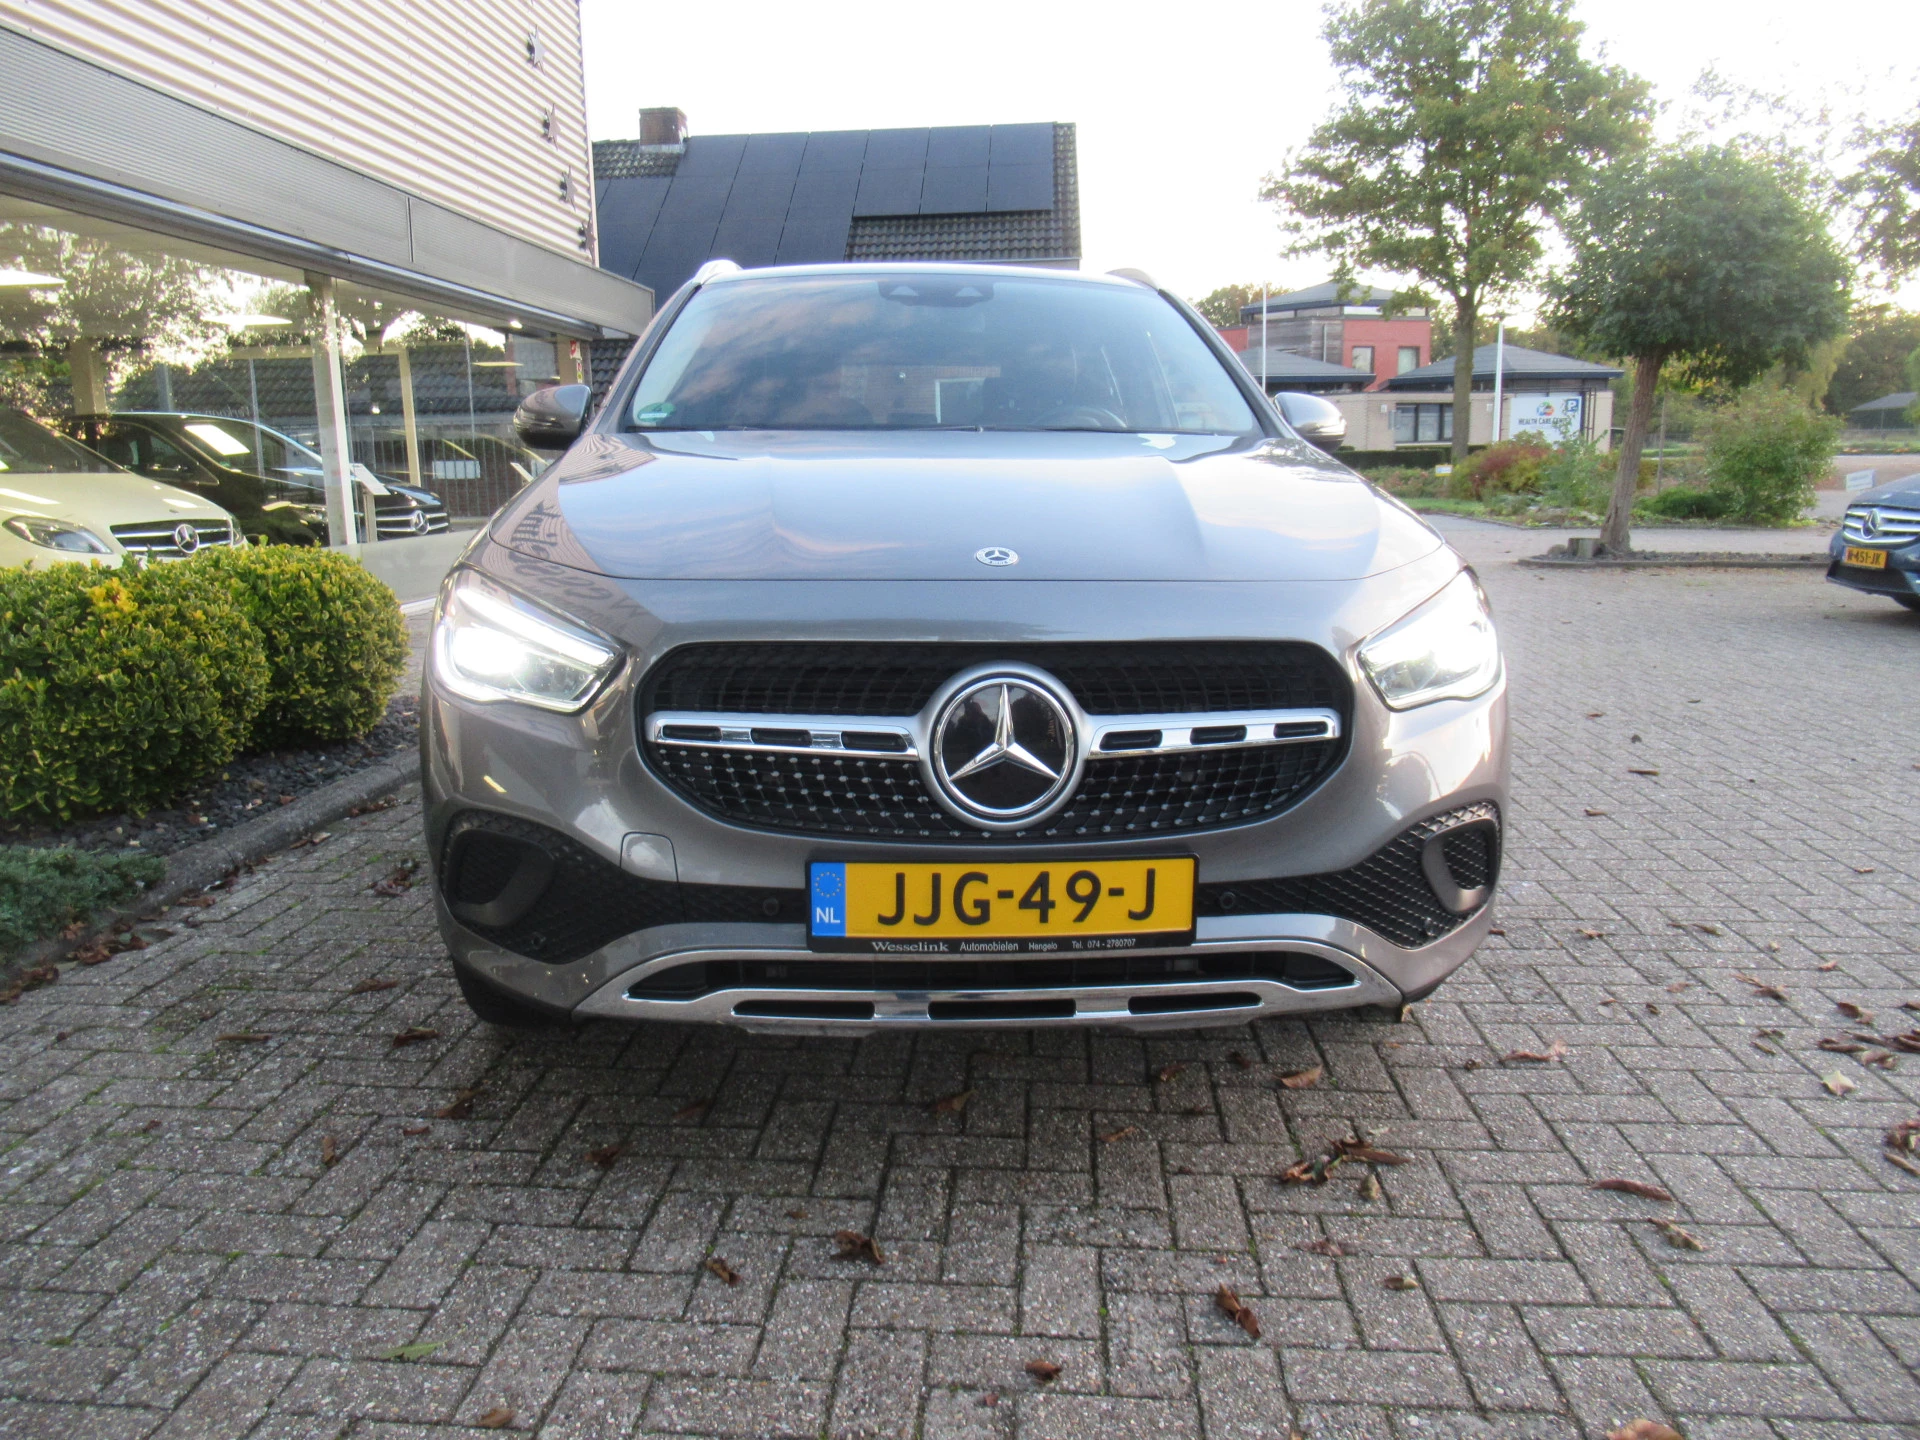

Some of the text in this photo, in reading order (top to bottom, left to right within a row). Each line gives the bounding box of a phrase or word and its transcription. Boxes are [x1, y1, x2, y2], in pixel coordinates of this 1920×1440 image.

[1567, 400, 1577, 411] P
[877, 868, 1156, 926] JJG-49-J
[815, 907, 841, 924] NL
[872, 941, 949, 952] Wesselink
[959, 941, 1019, 951] Automobielen
[1028, 942, 1058, 951] Hengelo
[1071, 940, 1084, 949] Tel.
[1087, 940, 1100, 948] 074
